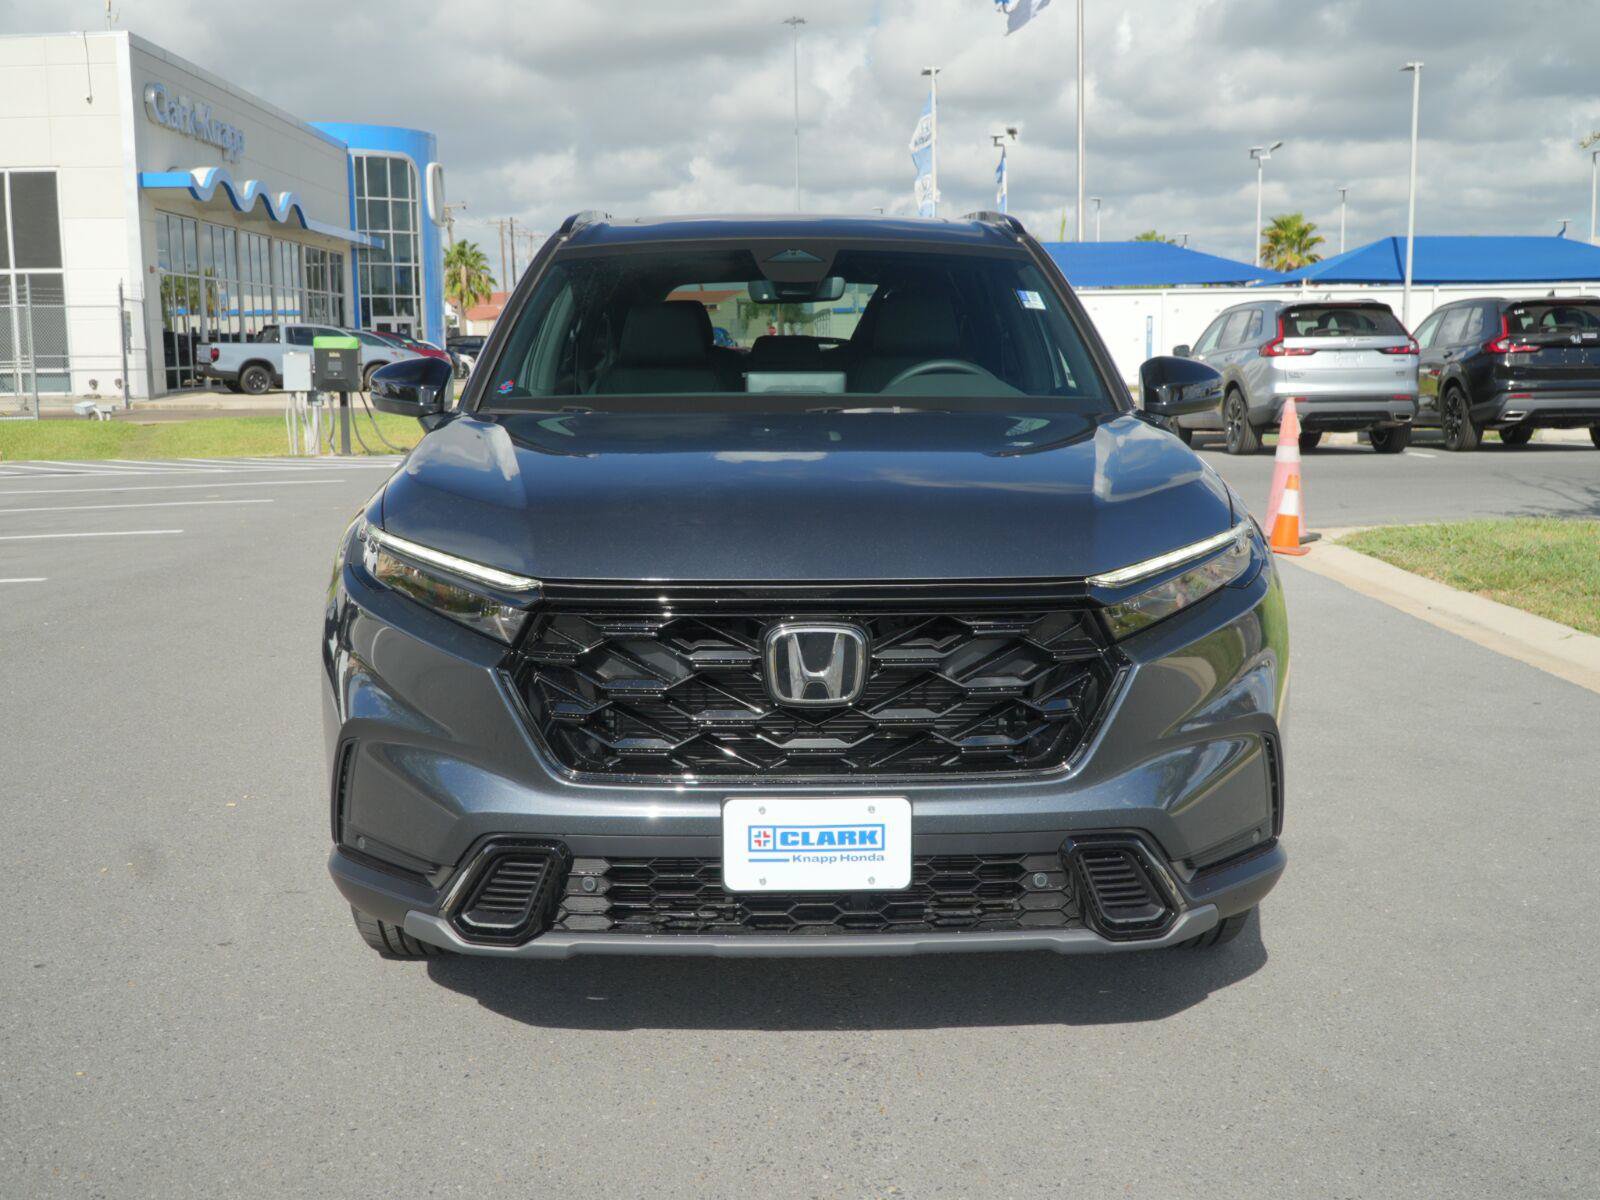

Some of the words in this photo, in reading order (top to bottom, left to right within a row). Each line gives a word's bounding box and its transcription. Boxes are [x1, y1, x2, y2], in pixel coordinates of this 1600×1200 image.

[780, 831, 878, 846] CLARK
[792, 855, 837, 864] Knapp
[840, 853, 884, 862] Honda
